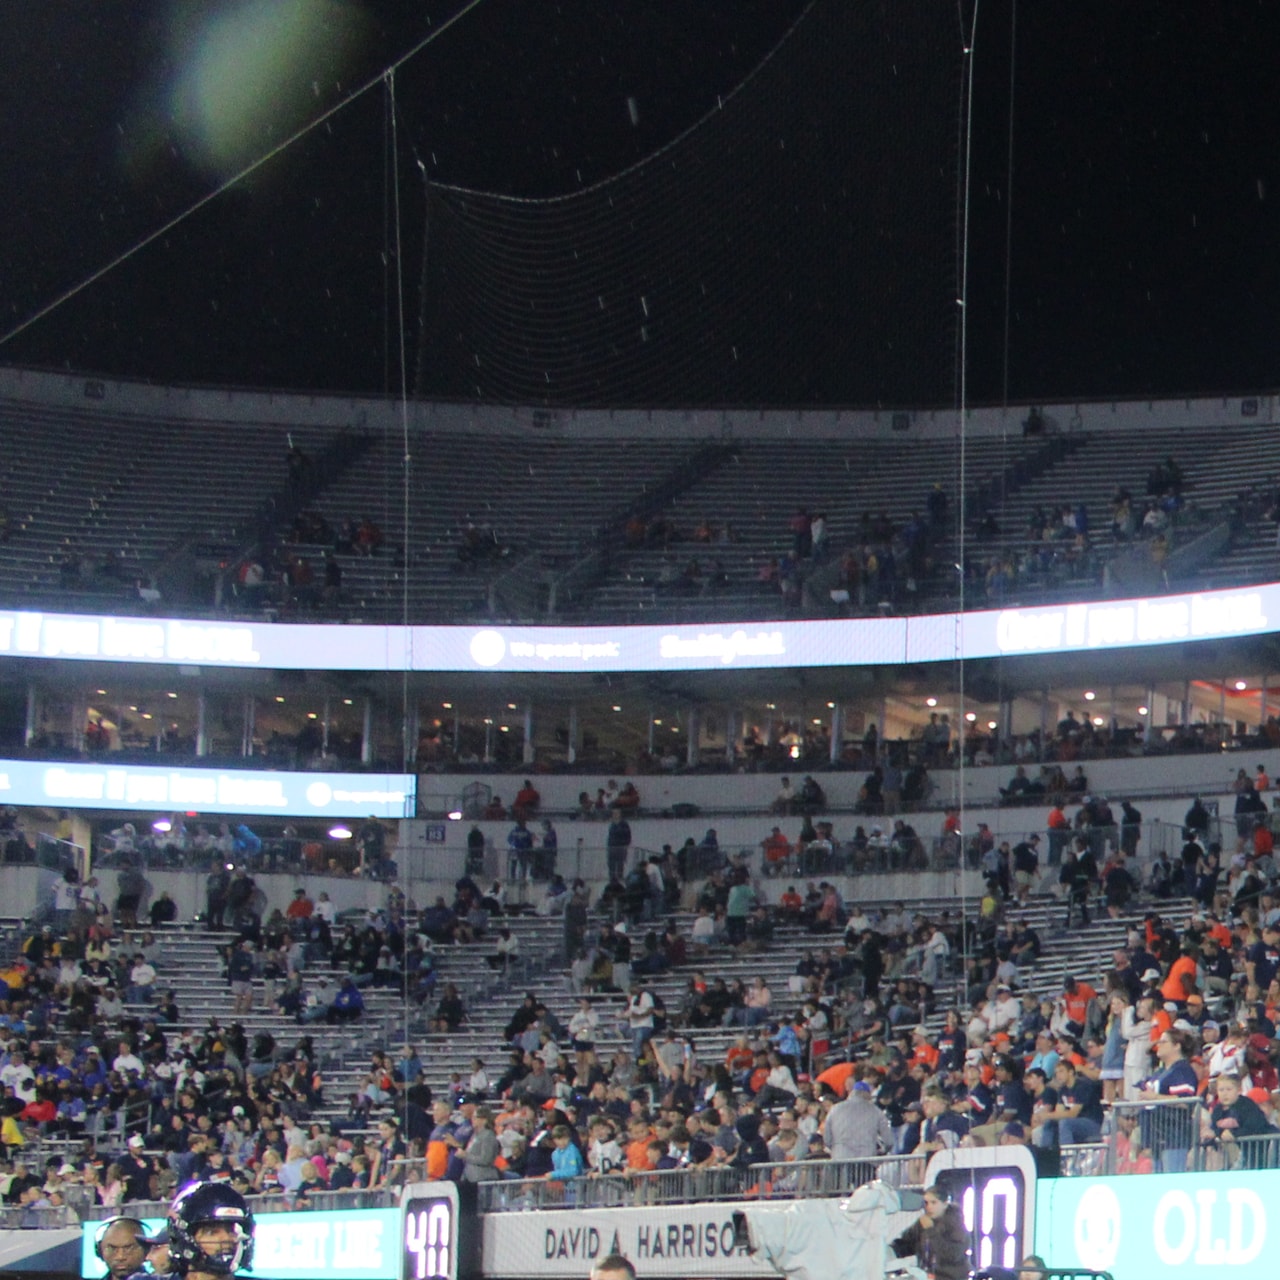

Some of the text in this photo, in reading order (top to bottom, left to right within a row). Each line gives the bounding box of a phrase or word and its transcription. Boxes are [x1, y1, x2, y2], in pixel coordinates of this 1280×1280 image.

[1088, 606, 1134, 647] you
[406, 1203, 450, 1278] 40
[545, 1226, 600, 1260] DAVID
[636, 1222, 749, 1259] HARRISO
[1153, 1188, 1267, 1266] OLD
